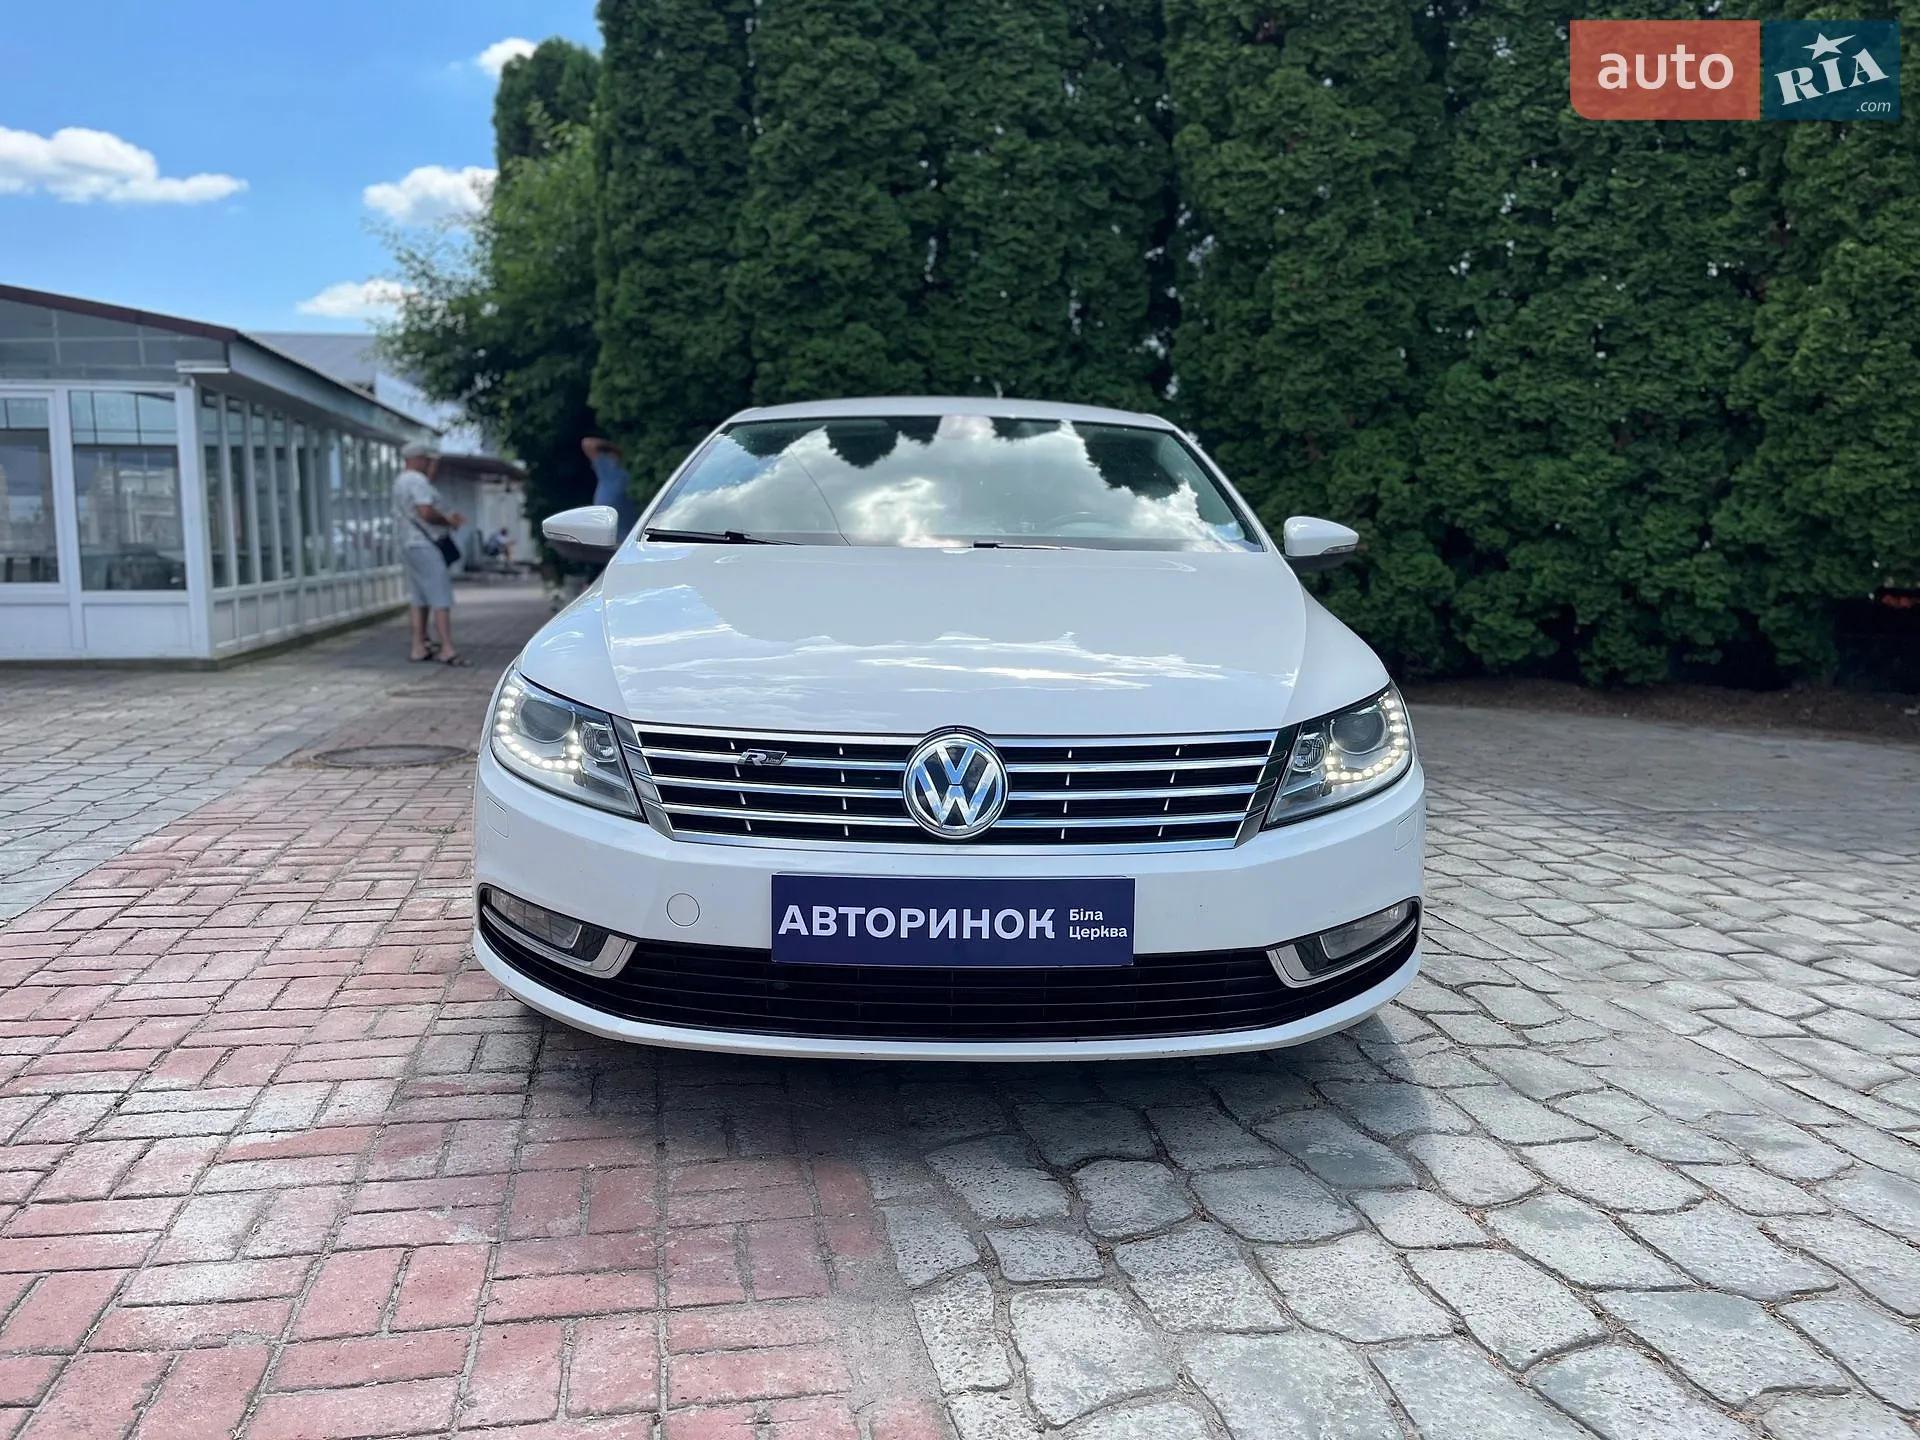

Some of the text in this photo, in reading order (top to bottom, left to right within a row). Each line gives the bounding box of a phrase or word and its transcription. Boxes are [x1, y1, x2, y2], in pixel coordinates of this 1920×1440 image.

[778, 904, 1056, 940] АВТОРИНОК
[1069, 908, 1104, 922] Біла
[1069, 925, 1128, 940] Церква
